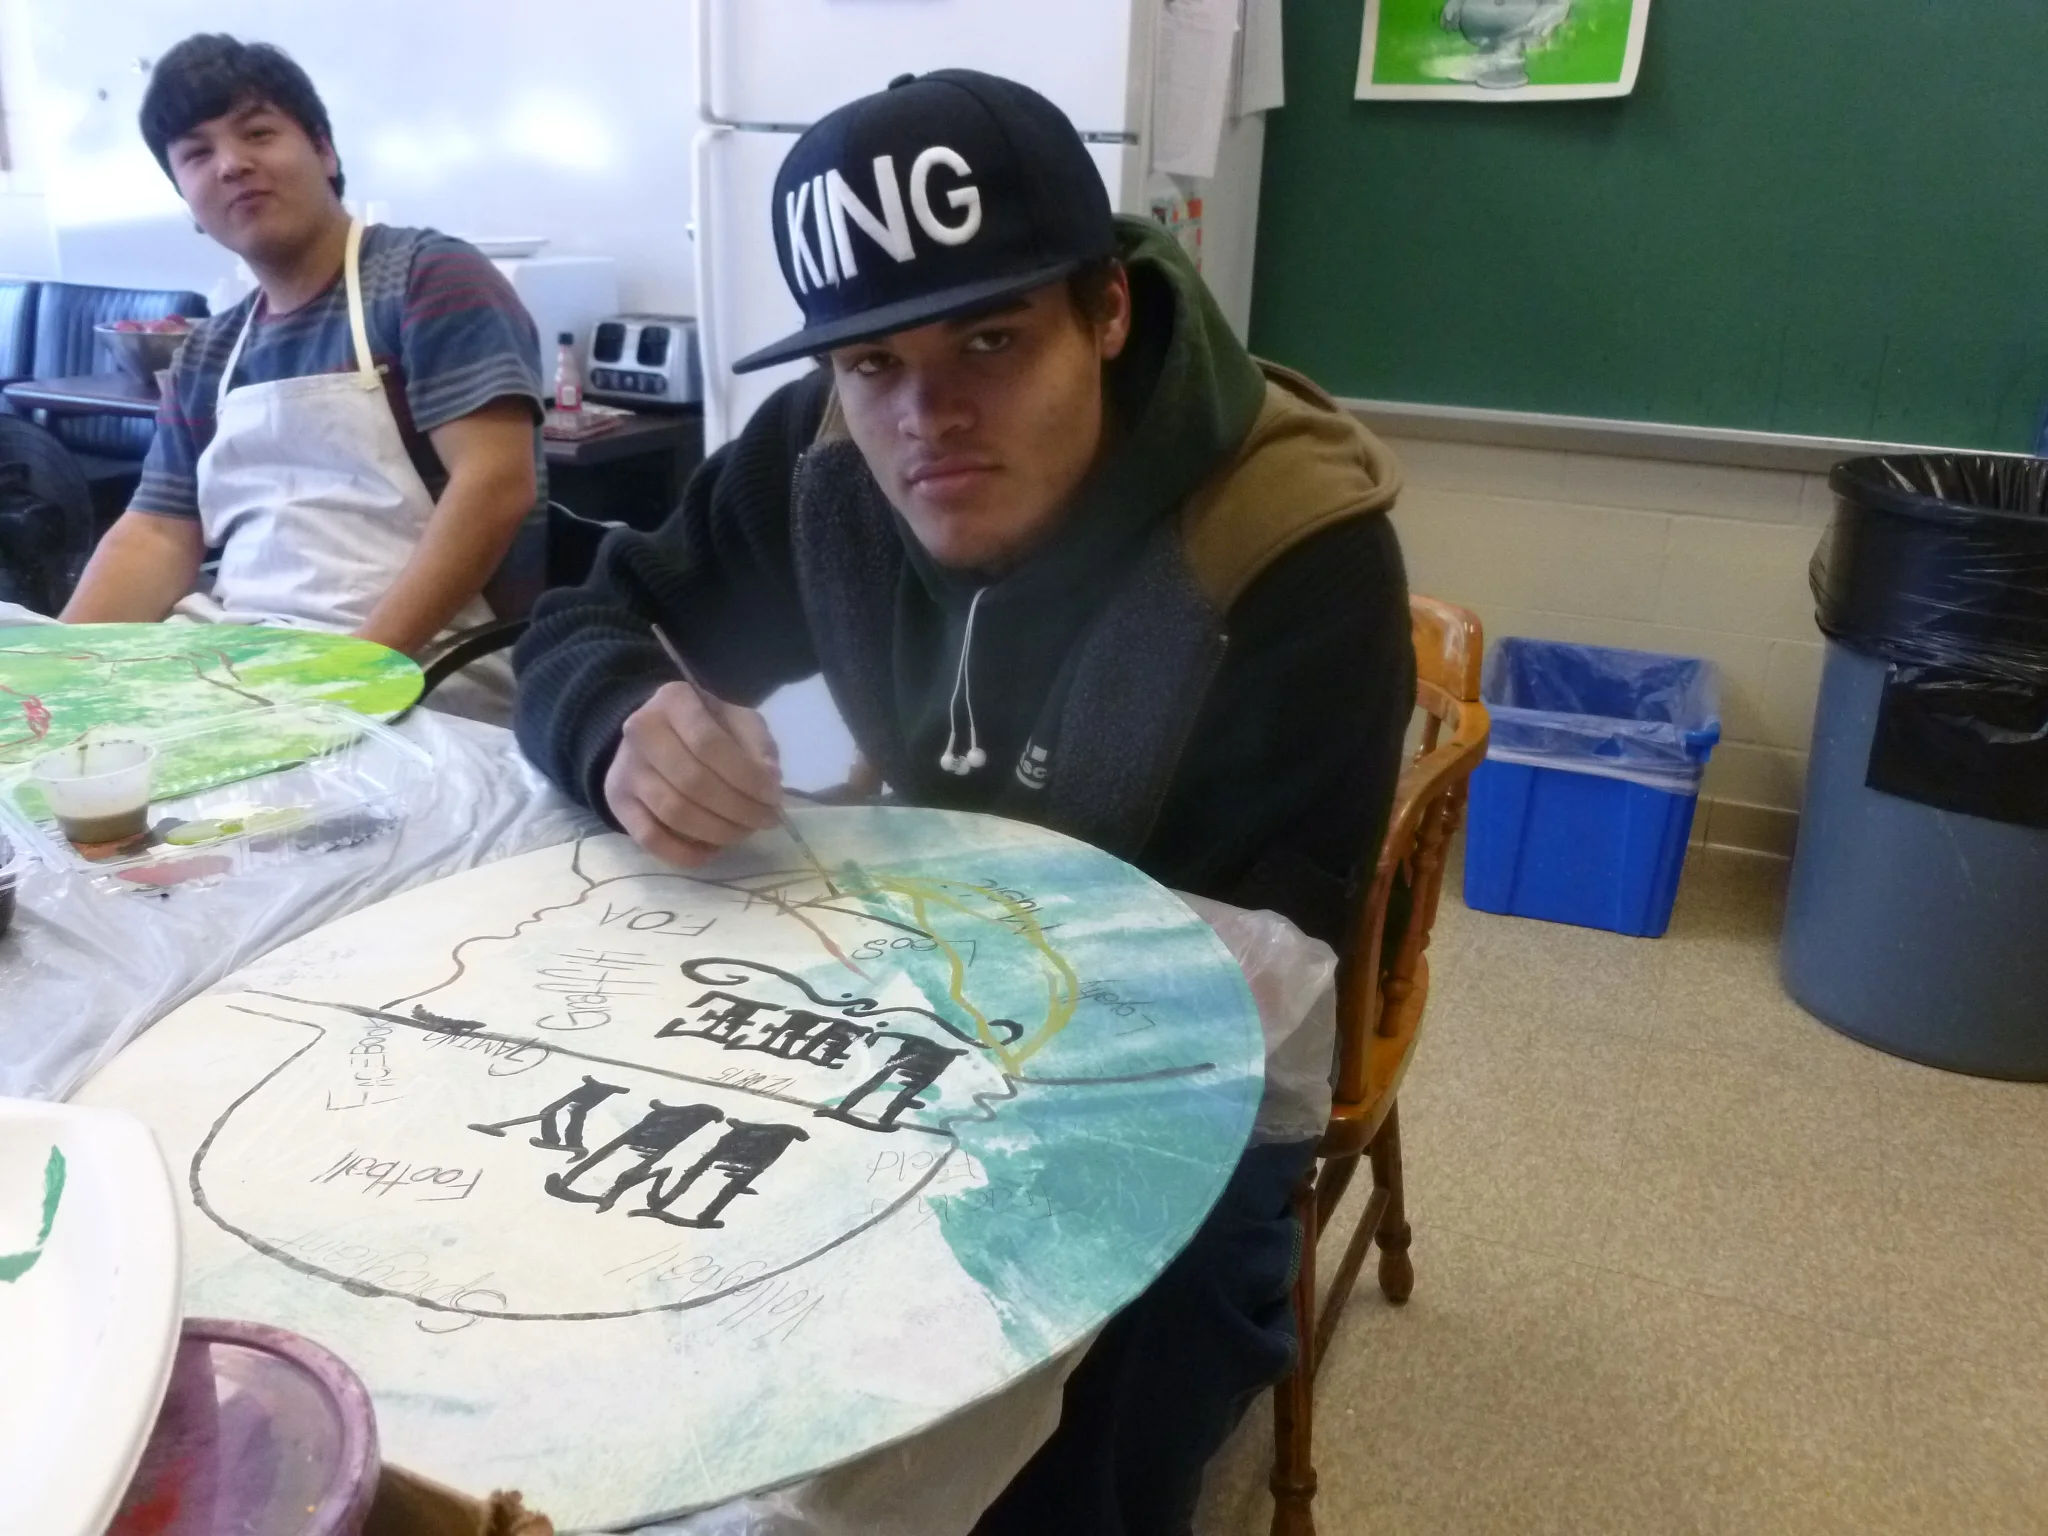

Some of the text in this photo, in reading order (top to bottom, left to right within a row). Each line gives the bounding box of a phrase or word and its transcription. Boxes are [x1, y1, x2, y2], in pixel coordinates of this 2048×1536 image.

[787, 146, 982, 295] KING
[532, 948, 665, 1031] Graffiti
[309, 1149, 484, 1202] Football
[867, 1151, 982, 1184] Feld
[603, 1242, 825, 1344] Volleyball
